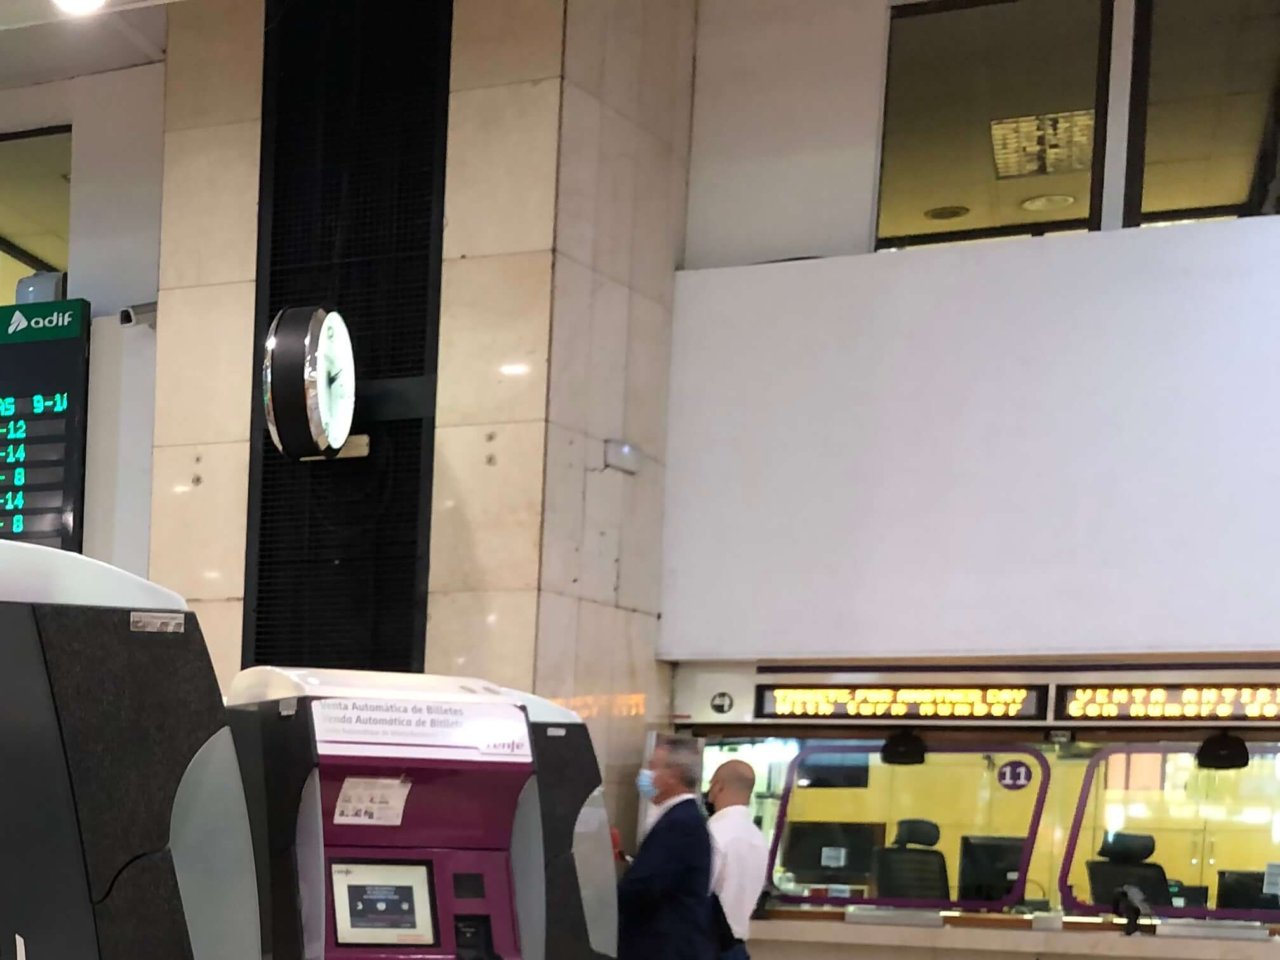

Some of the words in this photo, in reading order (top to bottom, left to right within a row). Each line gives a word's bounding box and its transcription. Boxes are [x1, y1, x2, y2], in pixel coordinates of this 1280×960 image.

[31, 311, 73, 328] adif
[1075, 687, 1167, 704] VENTA
[1068, 700, 1119, 718] Con
[1001, 765, 1029, 786] 11
